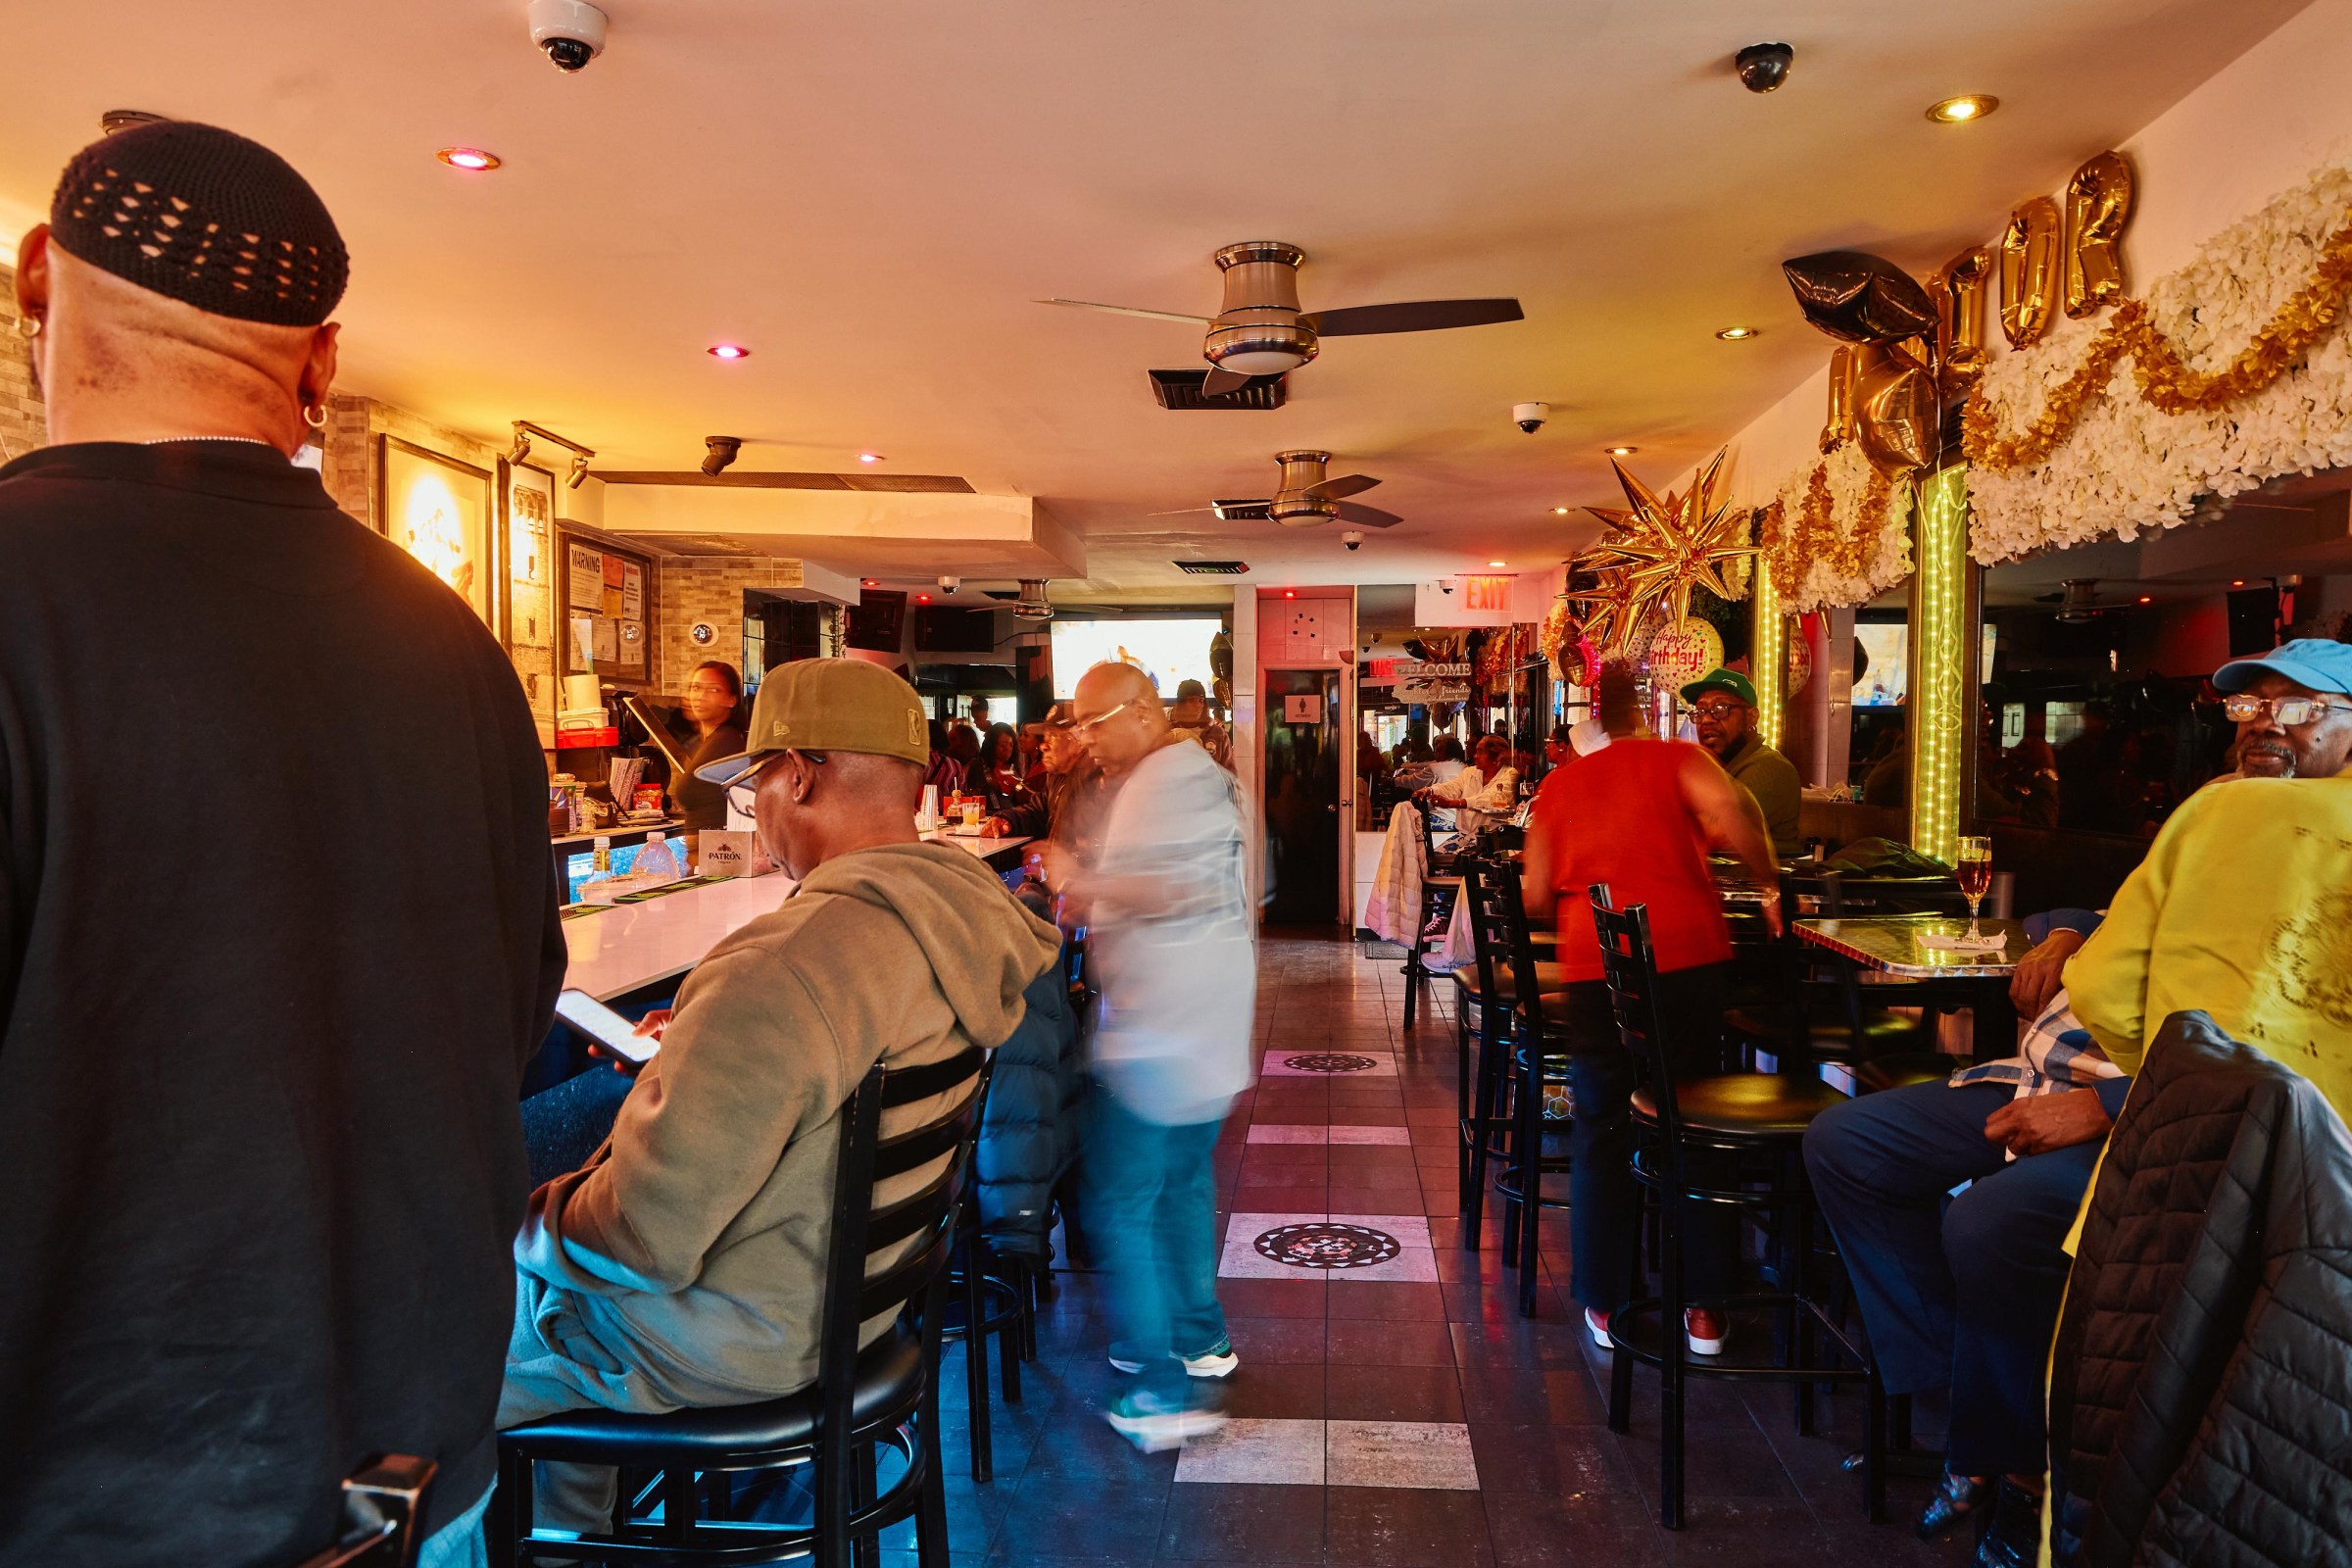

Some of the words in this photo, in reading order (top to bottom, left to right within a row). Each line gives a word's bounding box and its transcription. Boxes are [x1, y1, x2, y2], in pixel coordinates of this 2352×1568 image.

[571, 549, 600, 573] WARNING
[1466, 576, 1509, 610] EXIT
[1655, 628, 1693, 649] Happy
[1396, 662, 1471, 676] WELCOME
[1649, 645, 1703, 671] irthday!
[1442, 685, 1469, 697] friends
